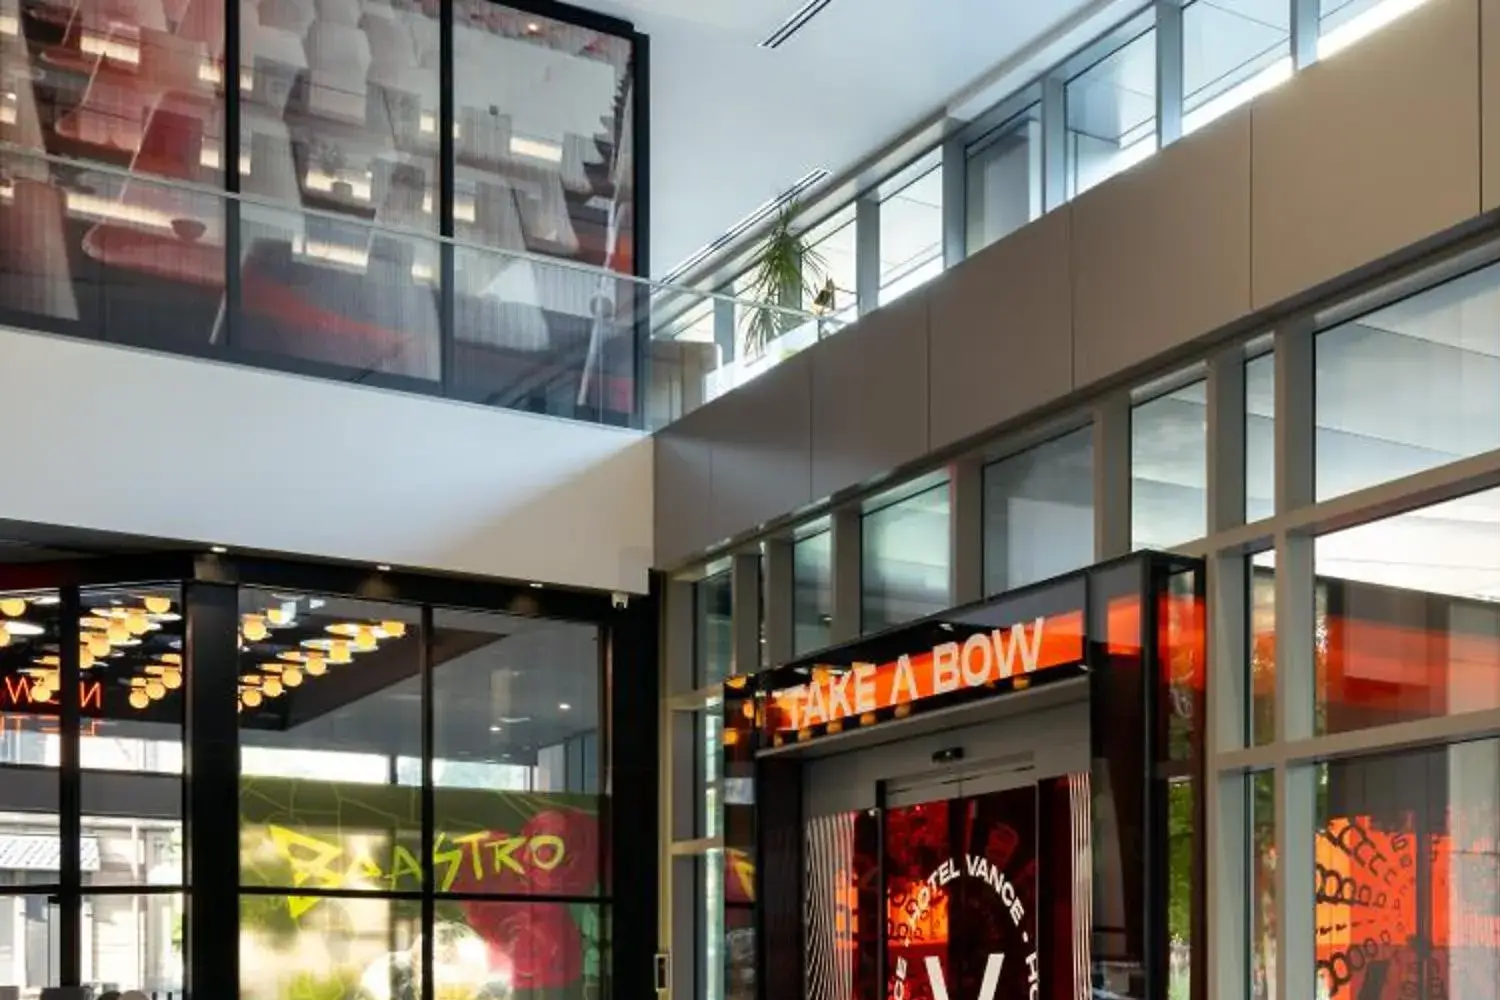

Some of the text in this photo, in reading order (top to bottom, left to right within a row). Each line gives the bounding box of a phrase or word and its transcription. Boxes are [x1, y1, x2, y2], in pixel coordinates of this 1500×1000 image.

[776, 661, 877, 730] TAKE
[933, 618, 1045, 694] BOW
[965, 853, 1025, 926] VANCE
